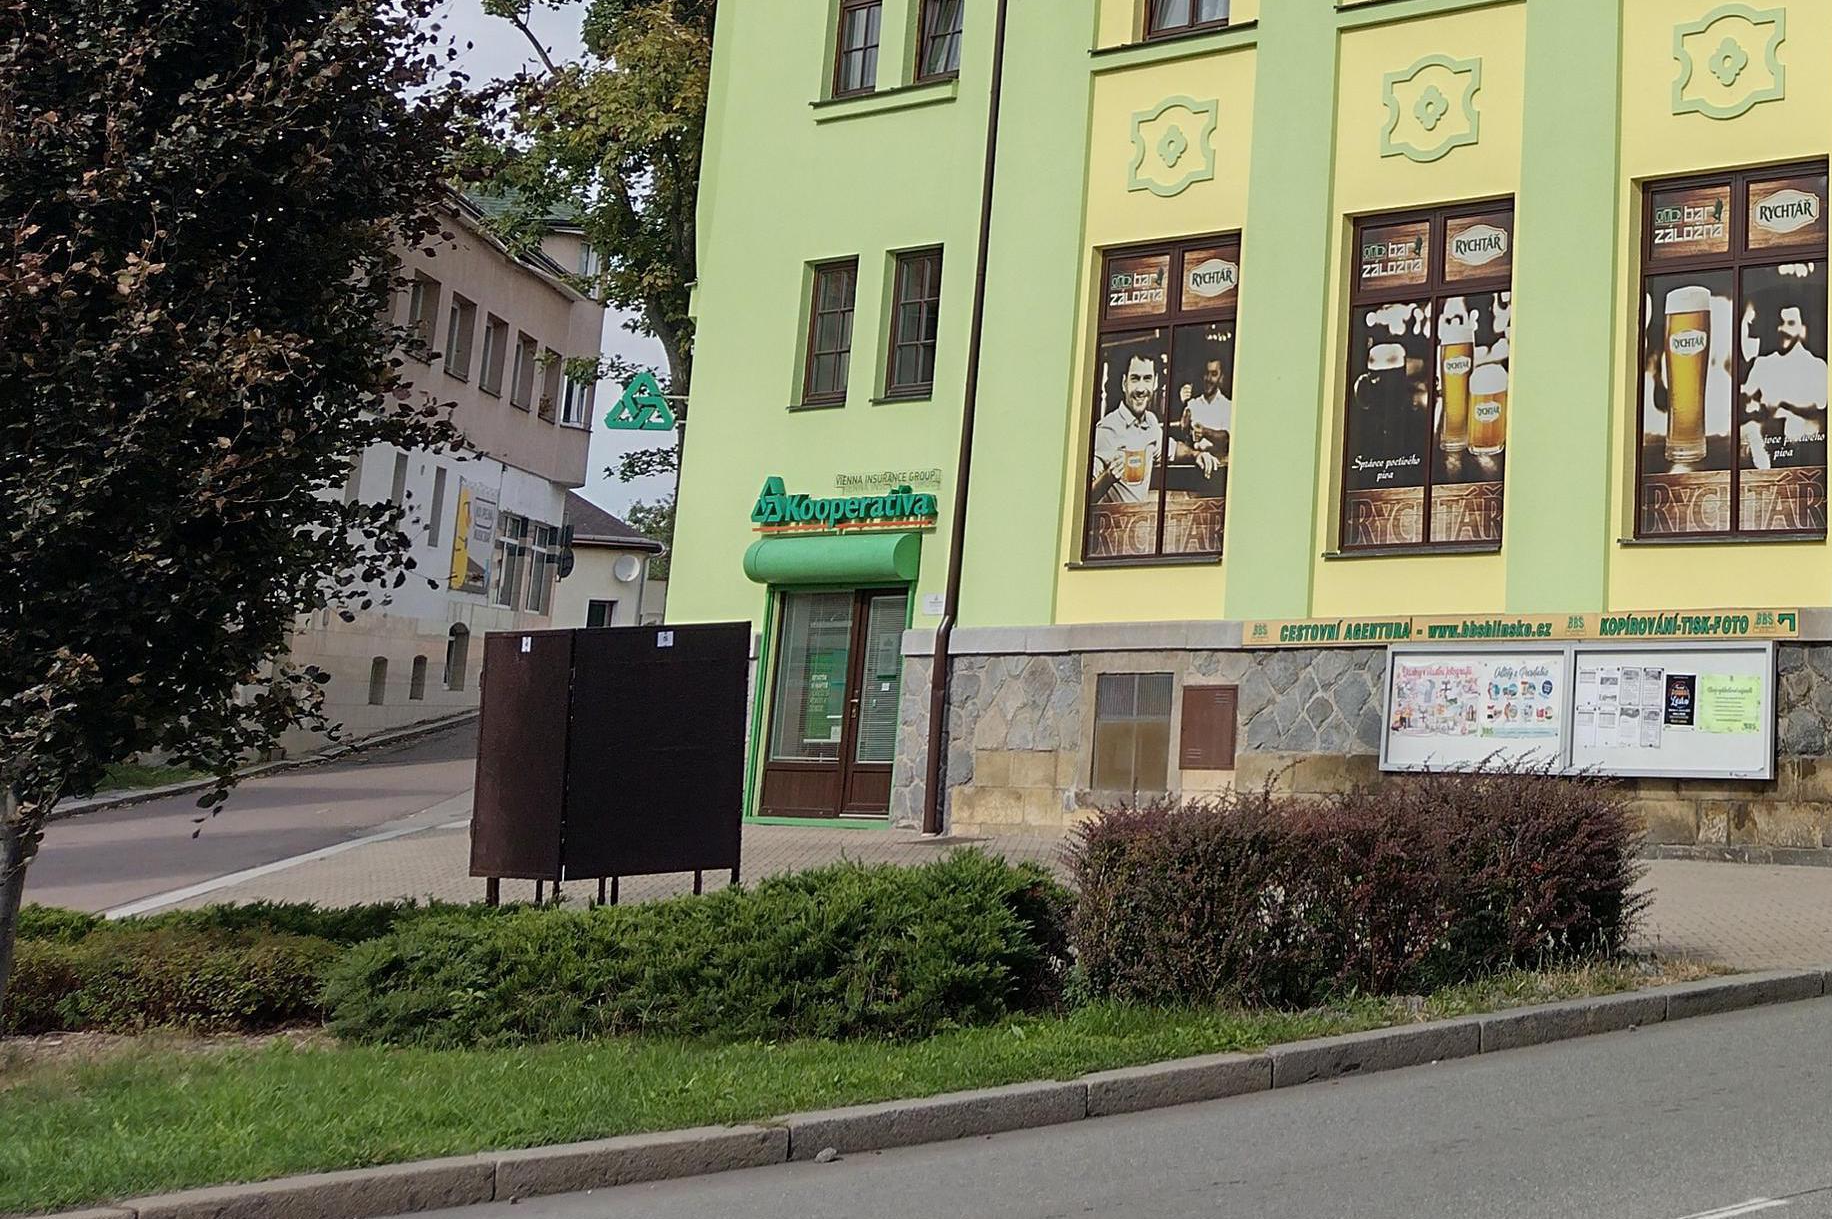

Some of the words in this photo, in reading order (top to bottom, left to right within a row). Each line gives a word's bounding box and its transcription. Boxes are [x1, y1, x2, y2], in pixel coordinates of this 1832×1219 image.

[1684, 206, 1715, 222] bar
[1760, 199, 1814, 222] RYCHTÁŘ
[1455, 234, 1503, 255] RYCHTÁŘ
[1191, 267, 1233, 287] RYCHTÁŘ
[836, 474, 863, 486] VIENNA
[865, 472, 906, 485] INSURANCE
[908, 470, 936, 482] GROUP
[784, 486, 930, 529] Kooperativa
[1567, 616, 1584, 629] BBS
[1756, 612, 1774, 626] BBS
[1280, 620, 1343, 642] CESTOVNÍ
[1344, 622, 1410, 641] AGENTURA
[1428, 620, 1552, 639] www.bbshlinsko.cz
